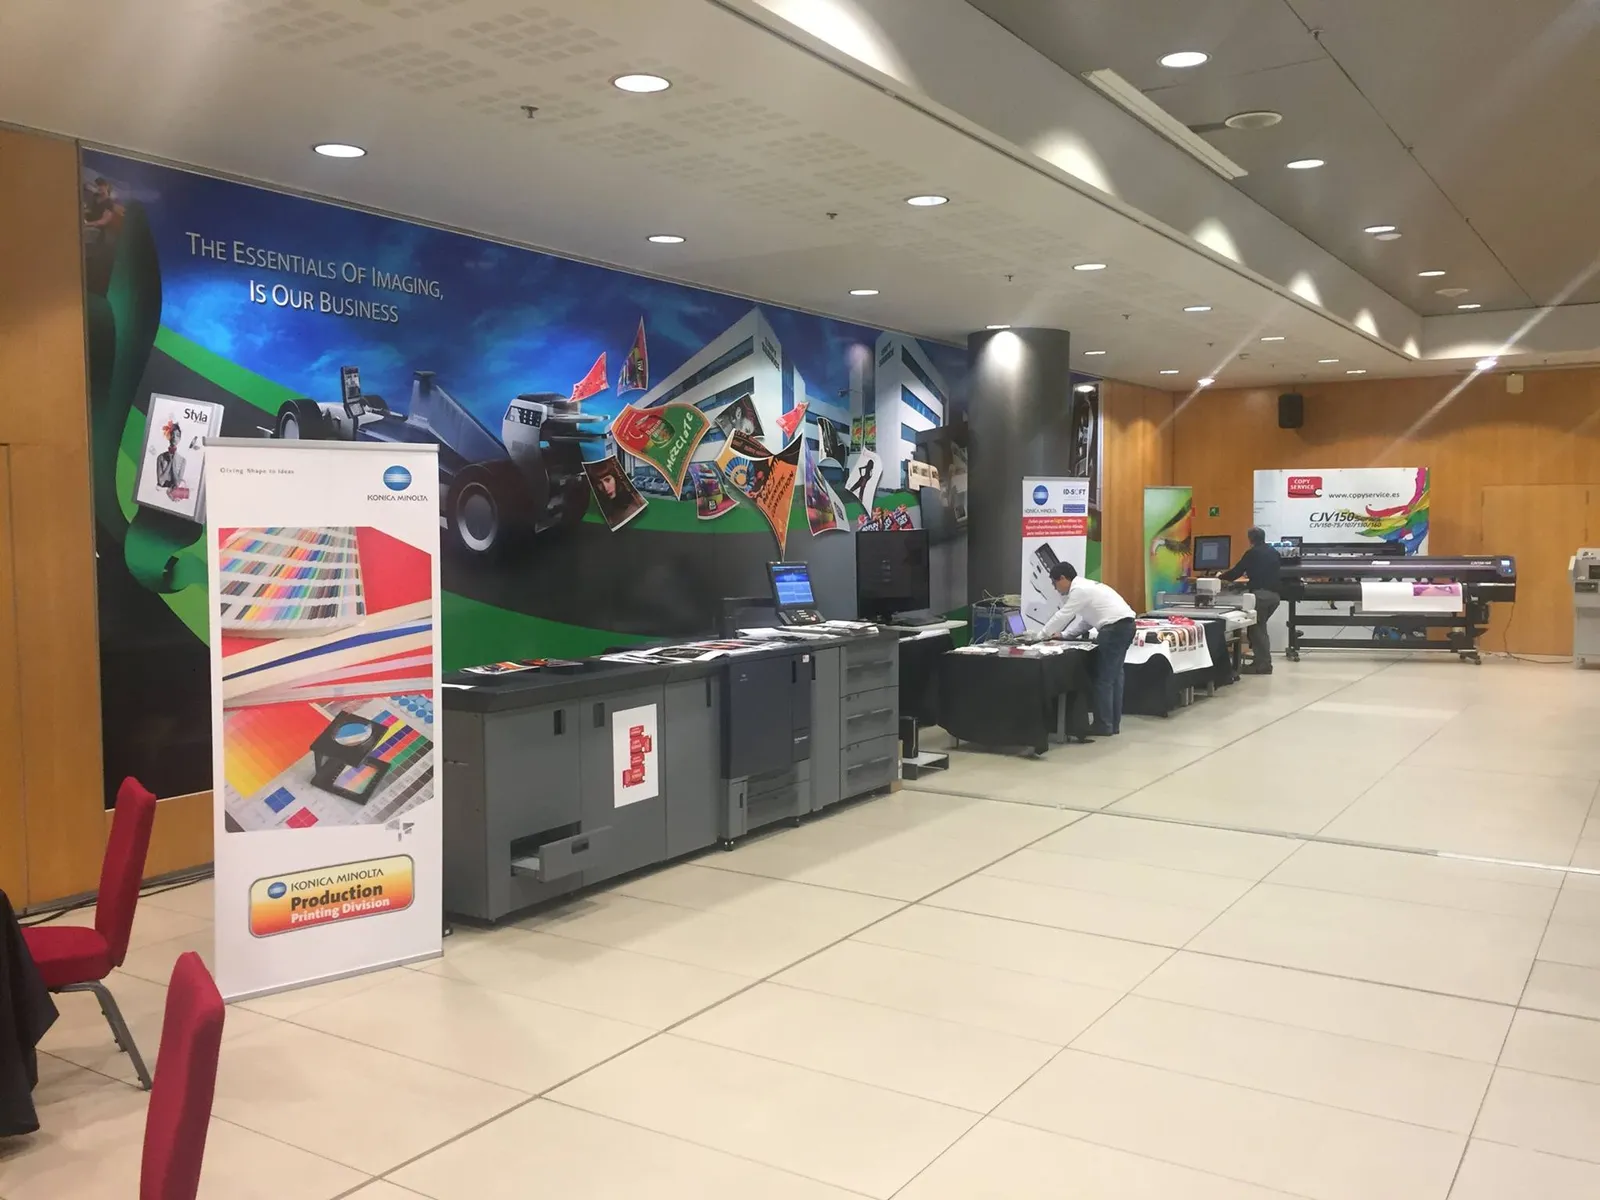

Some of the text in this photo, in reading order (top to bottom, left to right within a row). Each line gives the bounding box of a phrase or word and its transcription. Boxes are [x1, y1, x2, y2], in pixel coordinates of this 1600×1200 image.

[185, 231, 444, 300] THE ESSENTIALS OF IMAGING,
[249, 280, 400, 324] IS OUR BUSINESS
[183, 408, 208, 423] Styla
[397, 494, 428, 502] MINOLTA
[1329, 491, 1400, 499] www.copyservice.es
[1309, 511, 1355, 522] CJV150
[290, 868, 384, 893] KONICA MINOLTA
[290, 883, 383, 911] Production
[290, 897, 391, 924] Printing Division
